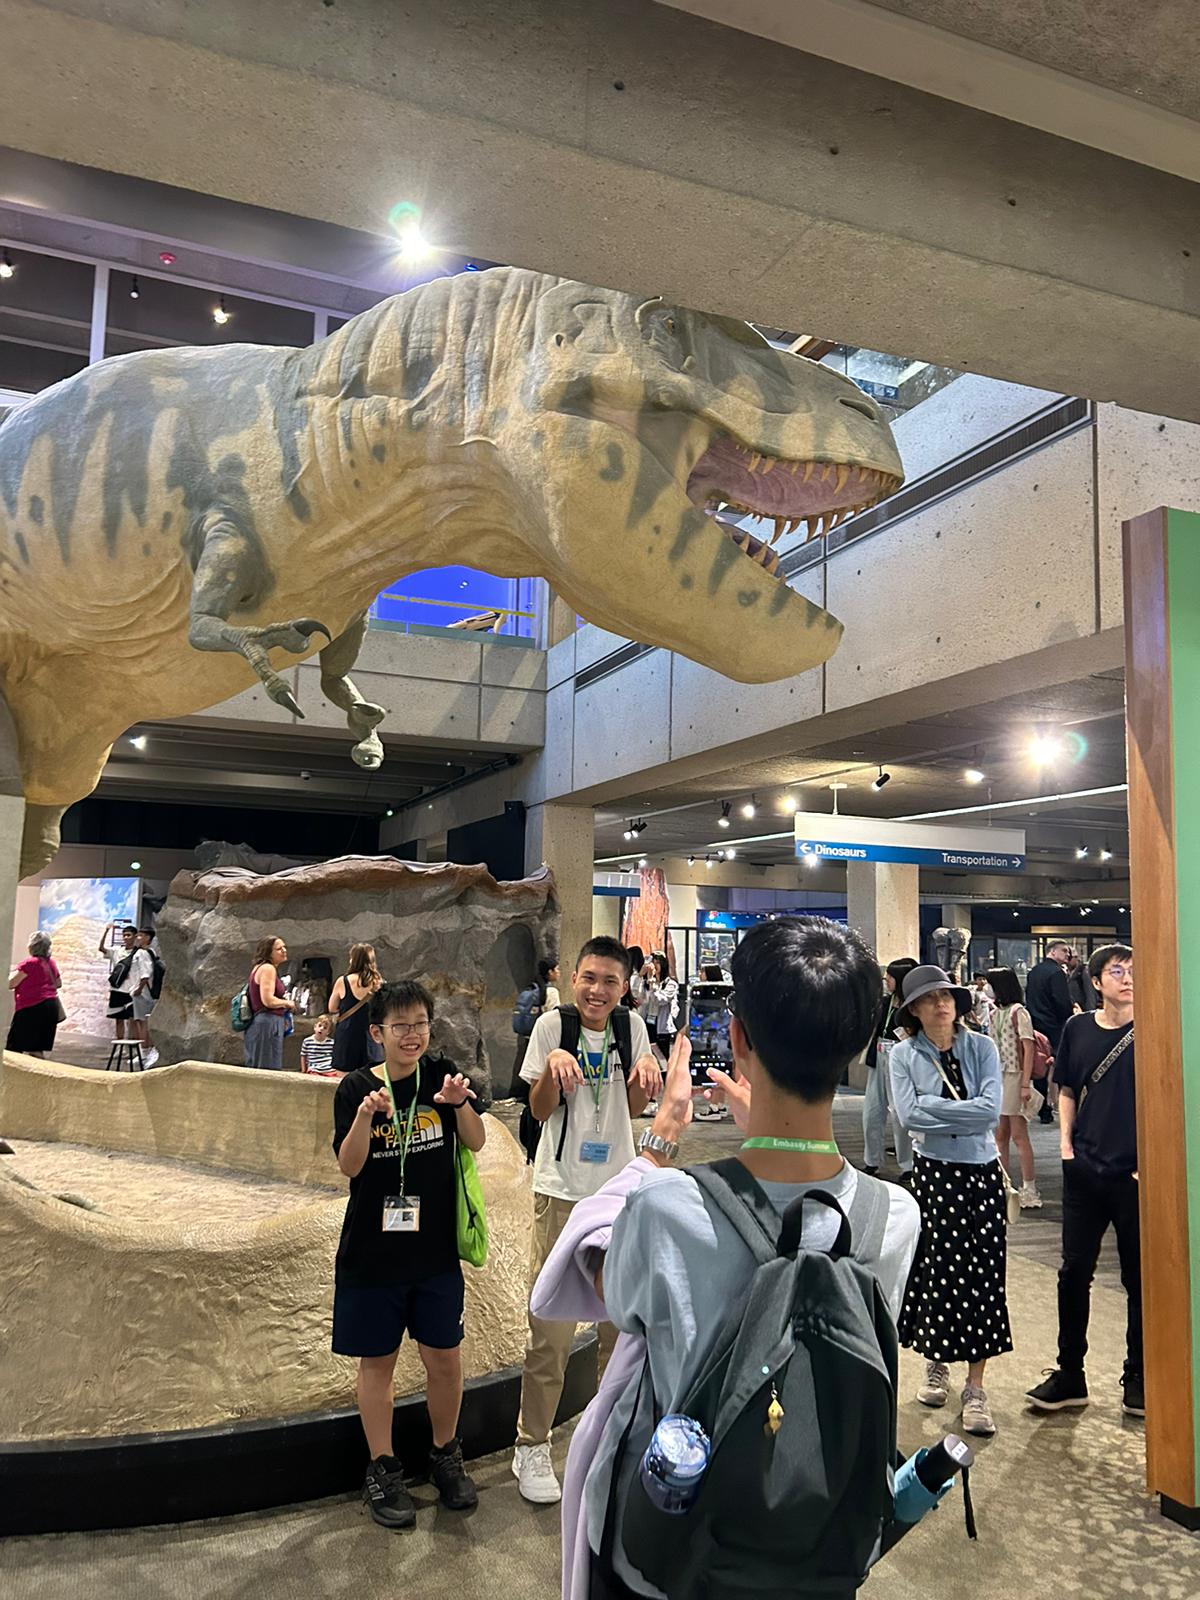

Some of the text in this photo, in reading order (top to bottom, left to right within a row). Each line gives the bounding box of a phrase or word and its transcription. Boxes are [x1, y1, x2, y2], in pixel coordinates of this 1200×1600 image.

[815, 844, 867, 858] Dinosaurs
[942, 852, 1008, 867] Transportation
[372, 1150, 394, 1159] NEVER
